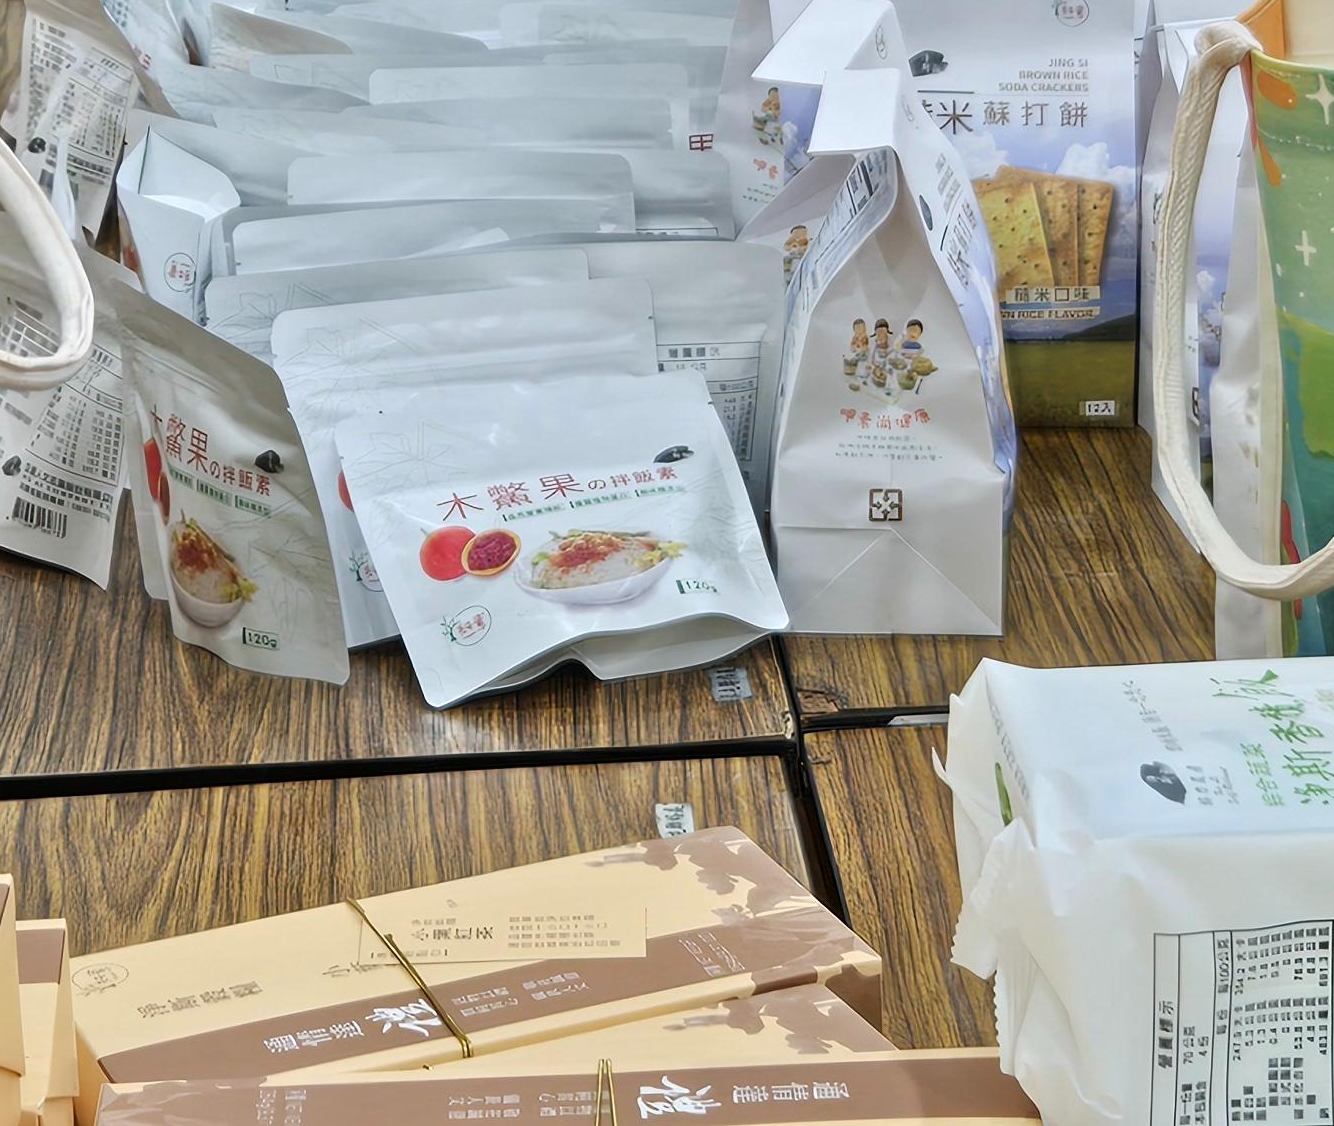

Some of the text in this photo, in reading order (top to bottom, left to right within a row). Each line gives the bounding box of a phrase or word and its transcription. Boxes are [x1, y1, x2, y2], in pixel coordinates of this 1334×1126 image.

[1048, 58, 1088, 68] JING SI
[1019, 70, 1088, 80] BROWN RICE
[998, 82, 1089, 92] SODA CRACKERS
[922, 99, 1088, 134] 米蘇打餅
[436, 467, 679, 522] 木鱉果の拌飯素
[683, 580, 719, 595] 120g
[247, 631, 279, 649] 120g
